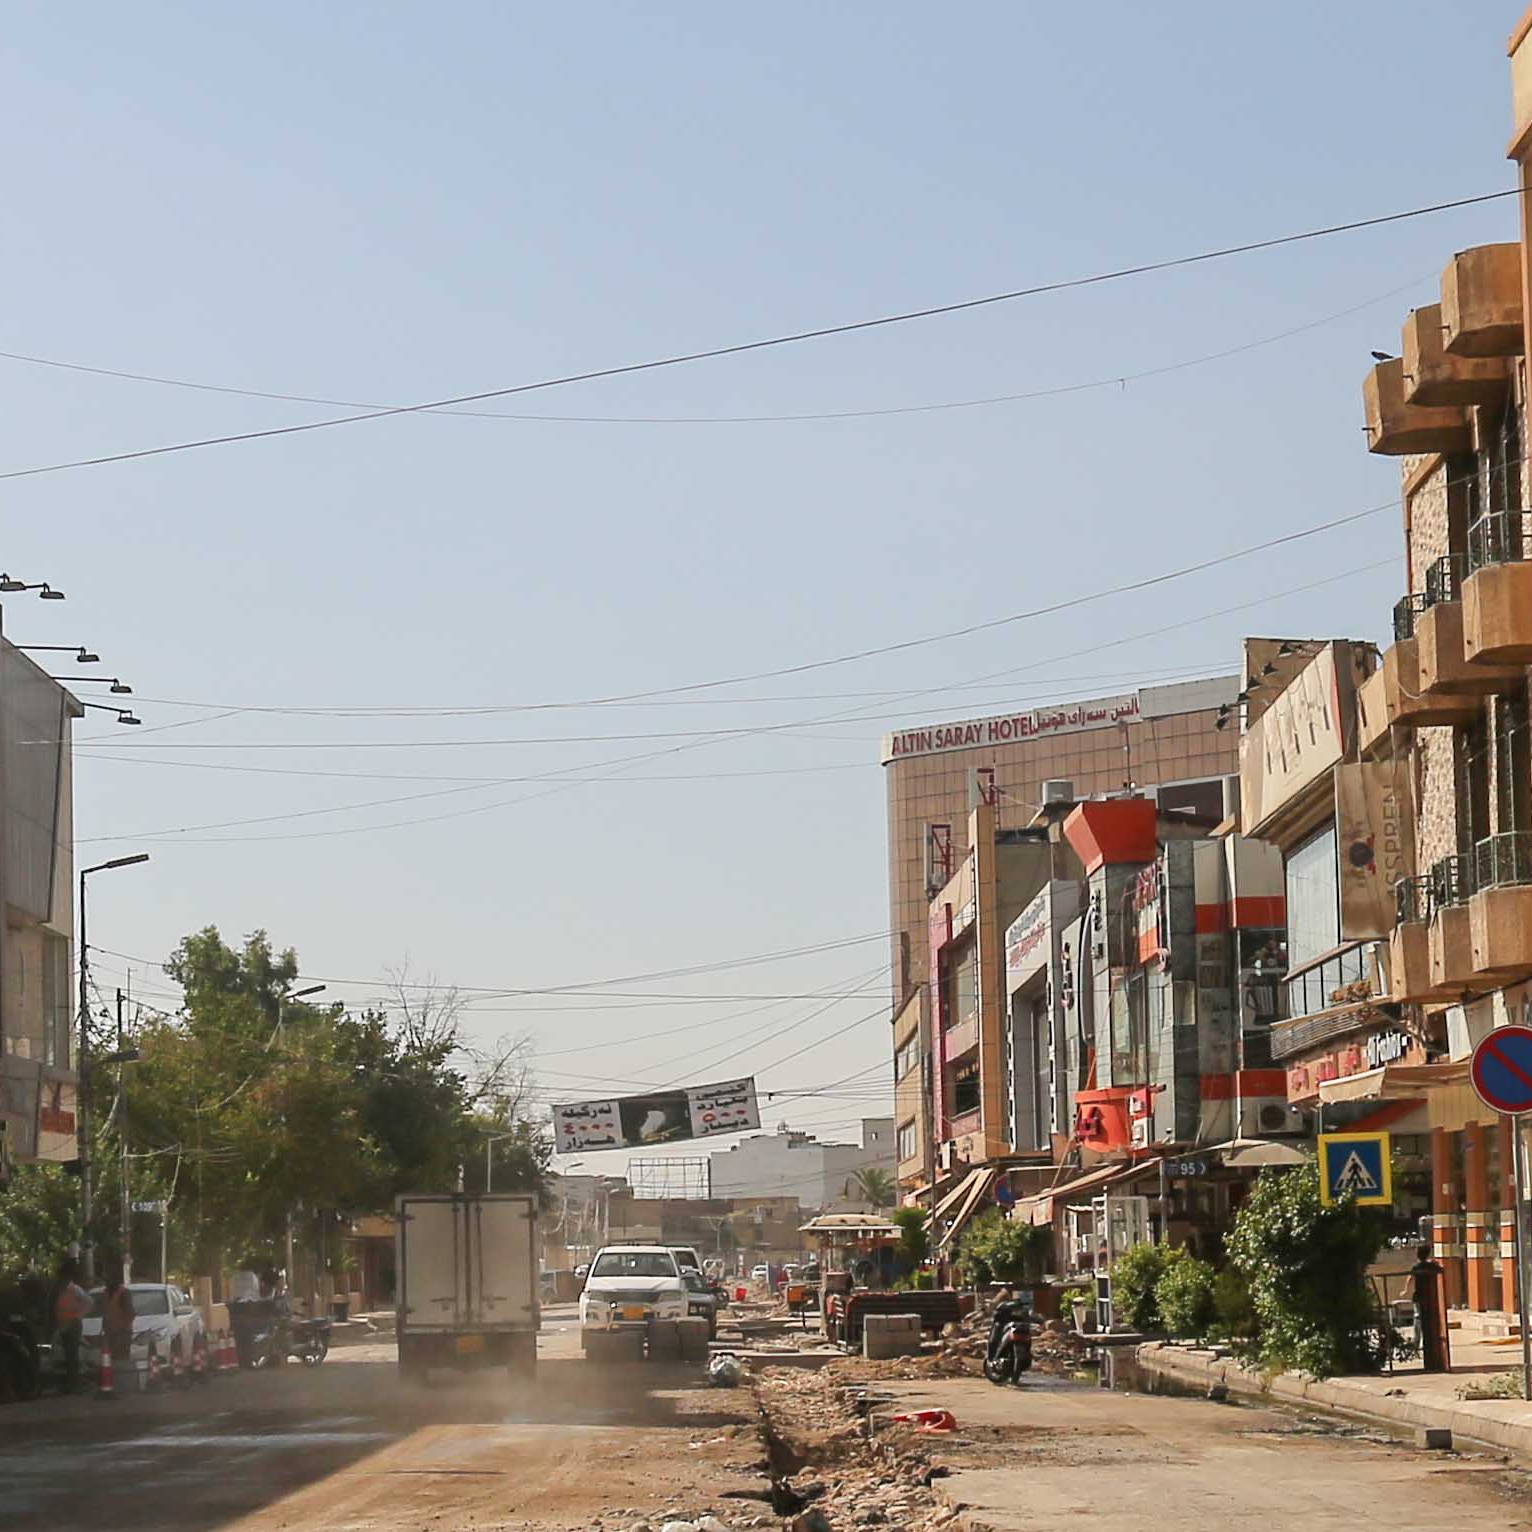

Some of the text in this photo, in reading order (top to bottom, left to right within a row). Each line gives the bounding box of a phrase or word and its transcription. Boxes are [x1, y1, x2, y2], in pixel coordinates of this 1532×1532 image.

[891, 715, 1034, 756] ALTIN SARAY HOTEL
